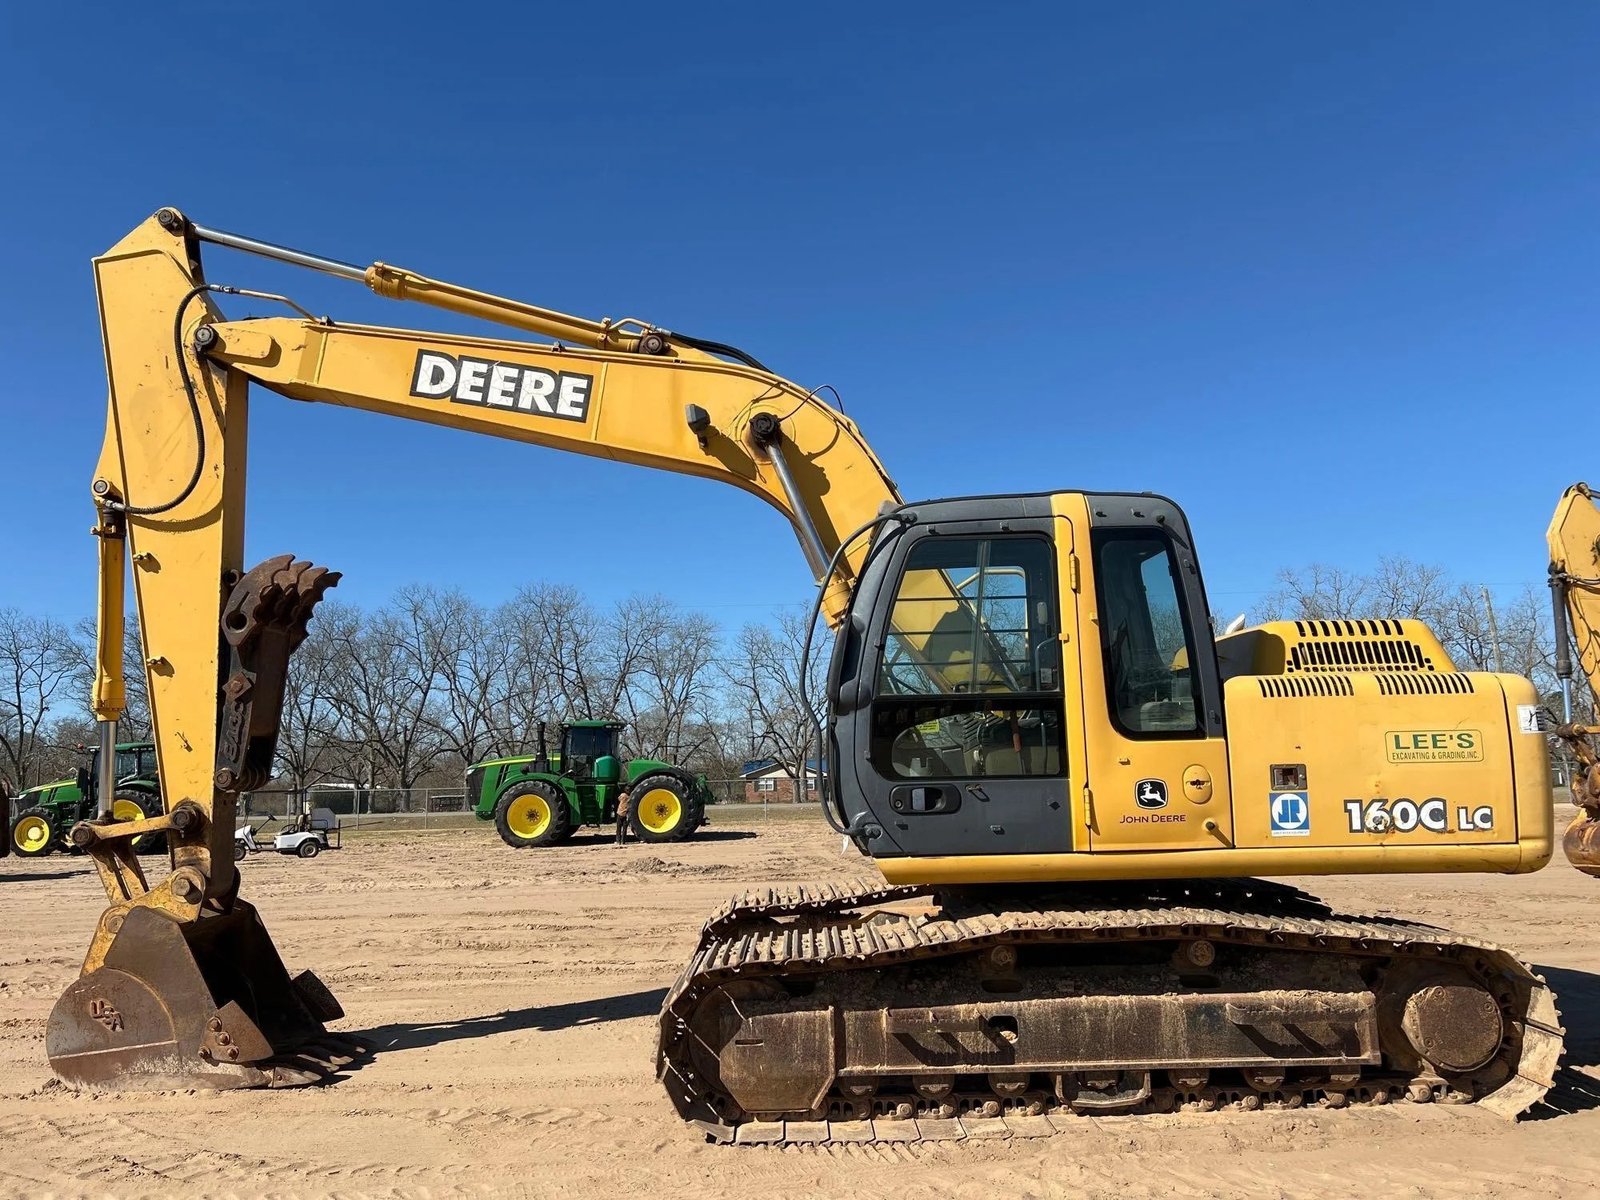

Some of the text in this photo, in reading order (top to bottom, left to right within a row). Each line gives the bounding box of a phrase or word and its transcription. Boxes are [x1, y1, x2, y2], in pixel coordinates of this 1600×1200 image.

[414, 352, 590, 419] DEERE
[1393, 733, 1475, 750] LEE'S
[1391, 751, 1430, 761] EXCAVATING
[1431, 751, 1436, 760] &
[1119, 814, 1187, 824] JOHN DEERE
[1345, 798, 1493, 833] 160C LC
